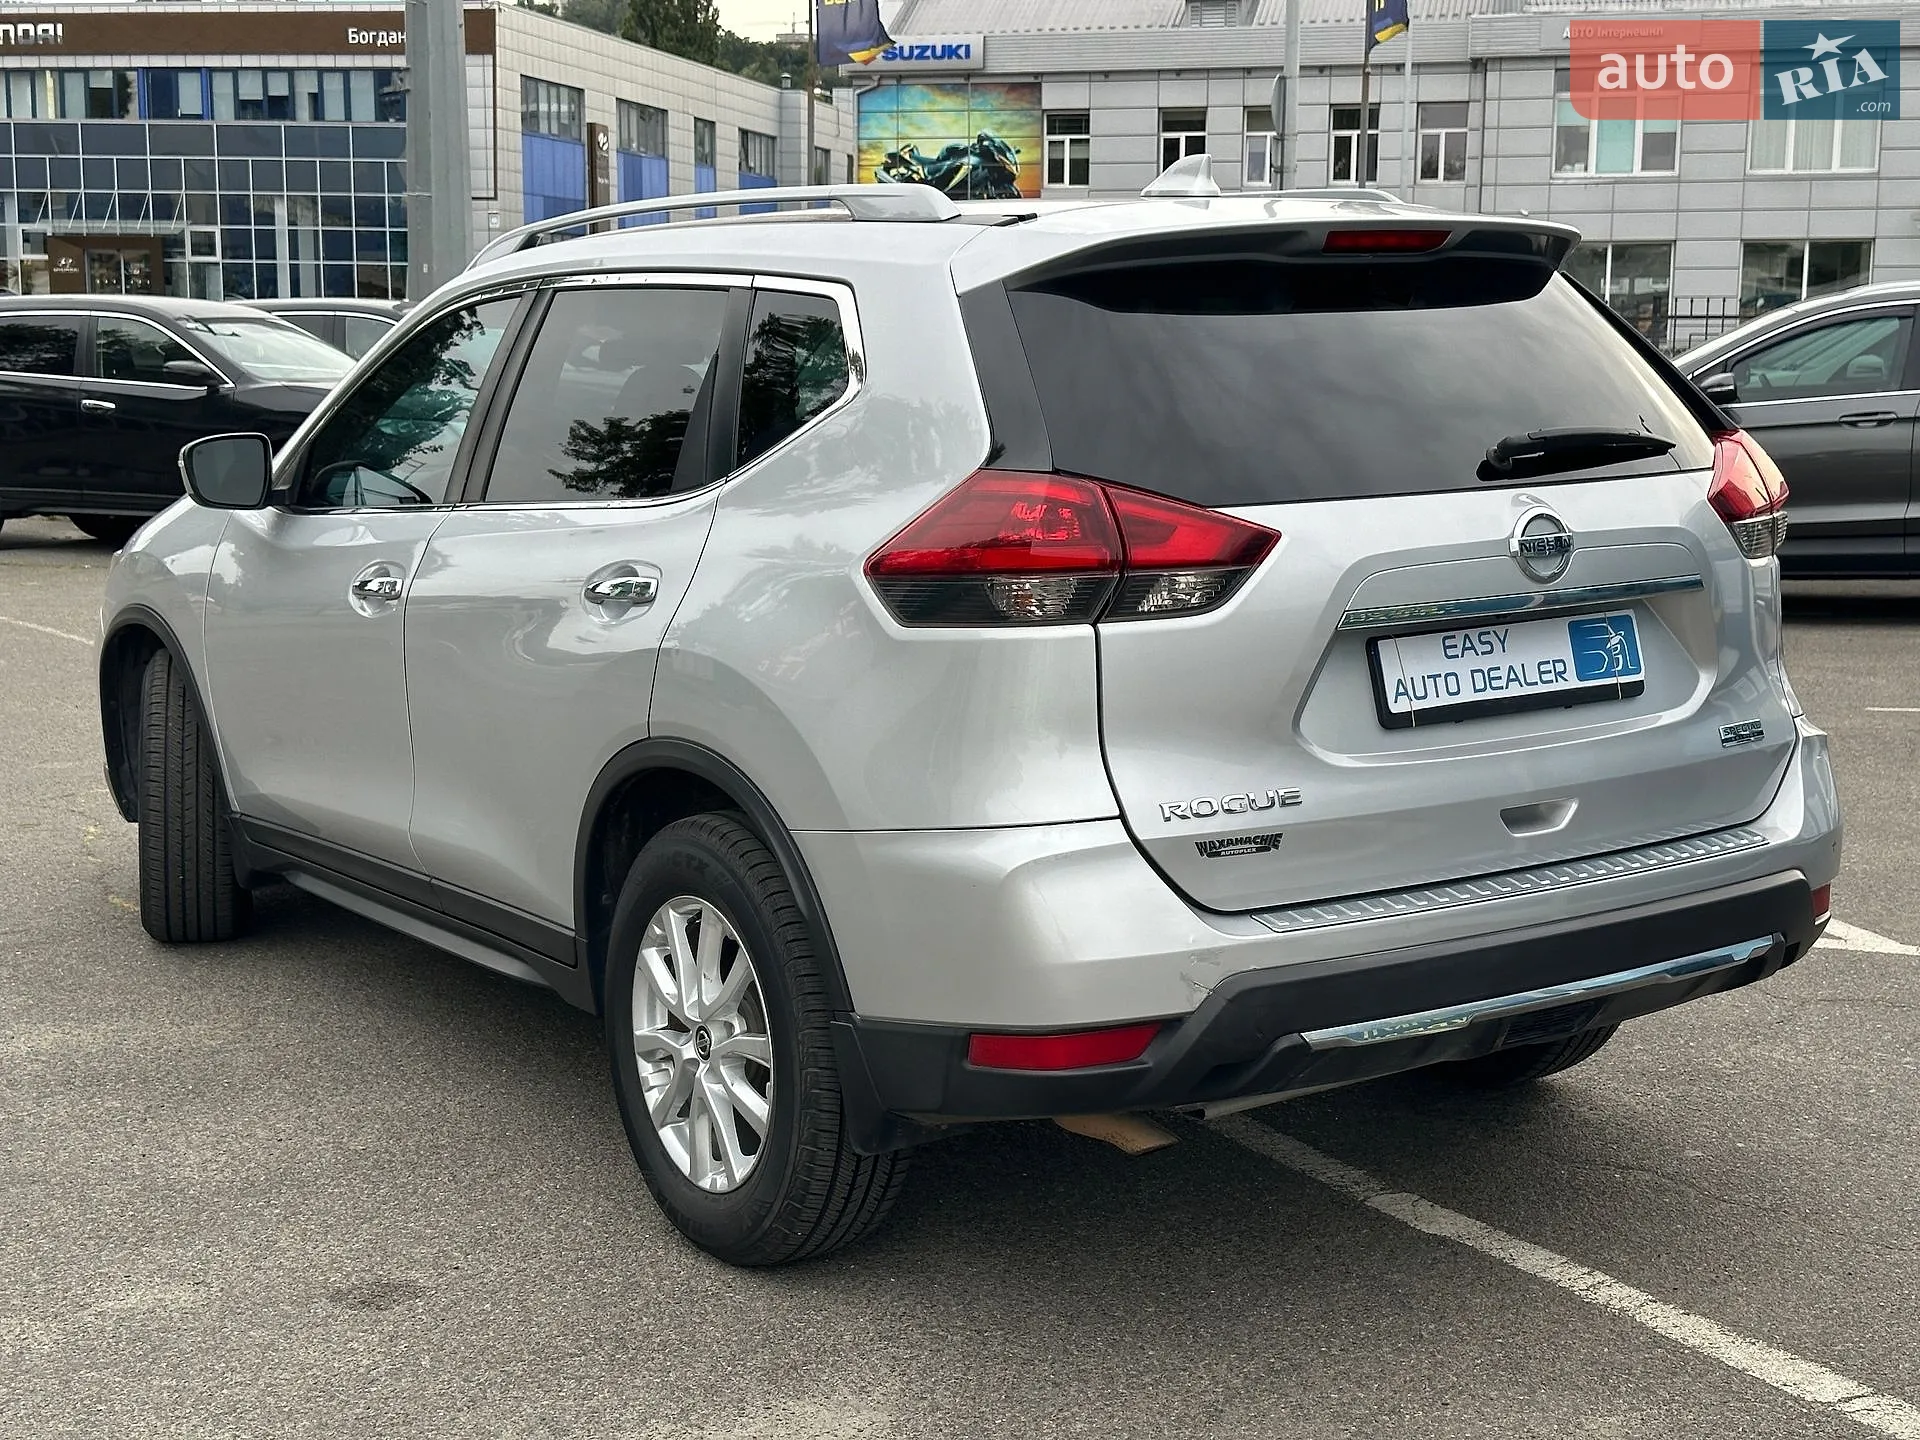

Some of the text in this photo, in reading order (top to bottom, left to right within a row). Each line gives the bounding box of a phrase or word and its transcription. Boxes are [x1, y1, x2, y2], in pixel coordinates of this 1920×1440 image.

[347, 27, 407, 47] Богдан
[882, 44, 971, 61] SUZUKI
[1520, 536, 1571, 554] NISSAN
[1442, 628, 1510, 660] EASY
[1394, 658, 1569, 704] AUTO DEALER
[1159, 787, 1303, 822] ROGUE
[1194, 832, 1283, 857] WAXAHACHIE
[1220, 847, 1257, 856] AUTOPLEX
